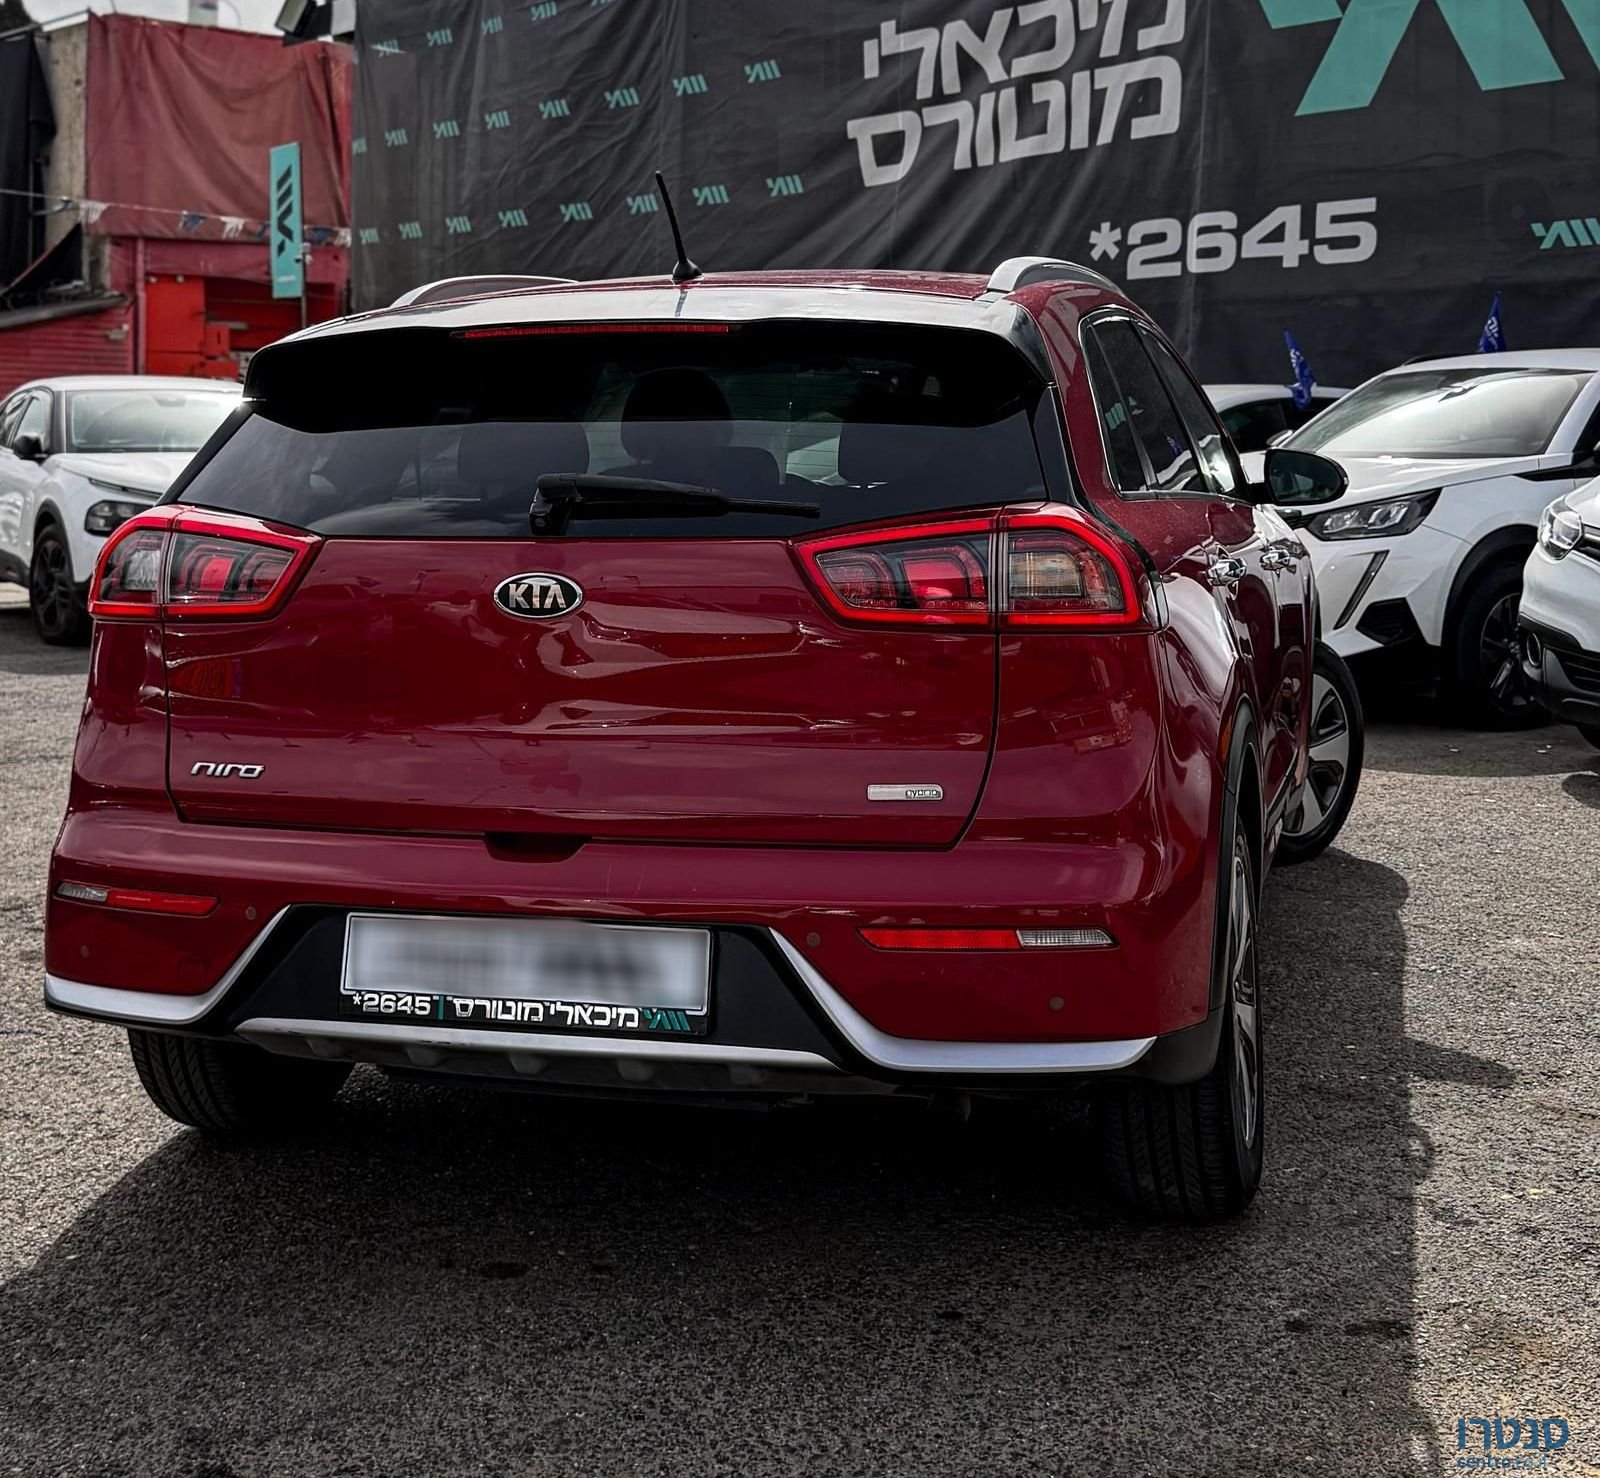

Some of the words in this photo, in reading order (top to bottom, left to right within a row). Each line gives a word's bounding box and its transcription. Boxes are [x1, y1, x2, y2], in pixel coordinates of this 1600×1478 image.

[863, 0, 1186, 100] מיכאלי
[847, 55, 1182, 187] מוטורס
[508, 583, 567, 609] KIA
[452, 998, 544, 1022] מוטורס
[550, 1001, 639, 1028] מיכאלי
